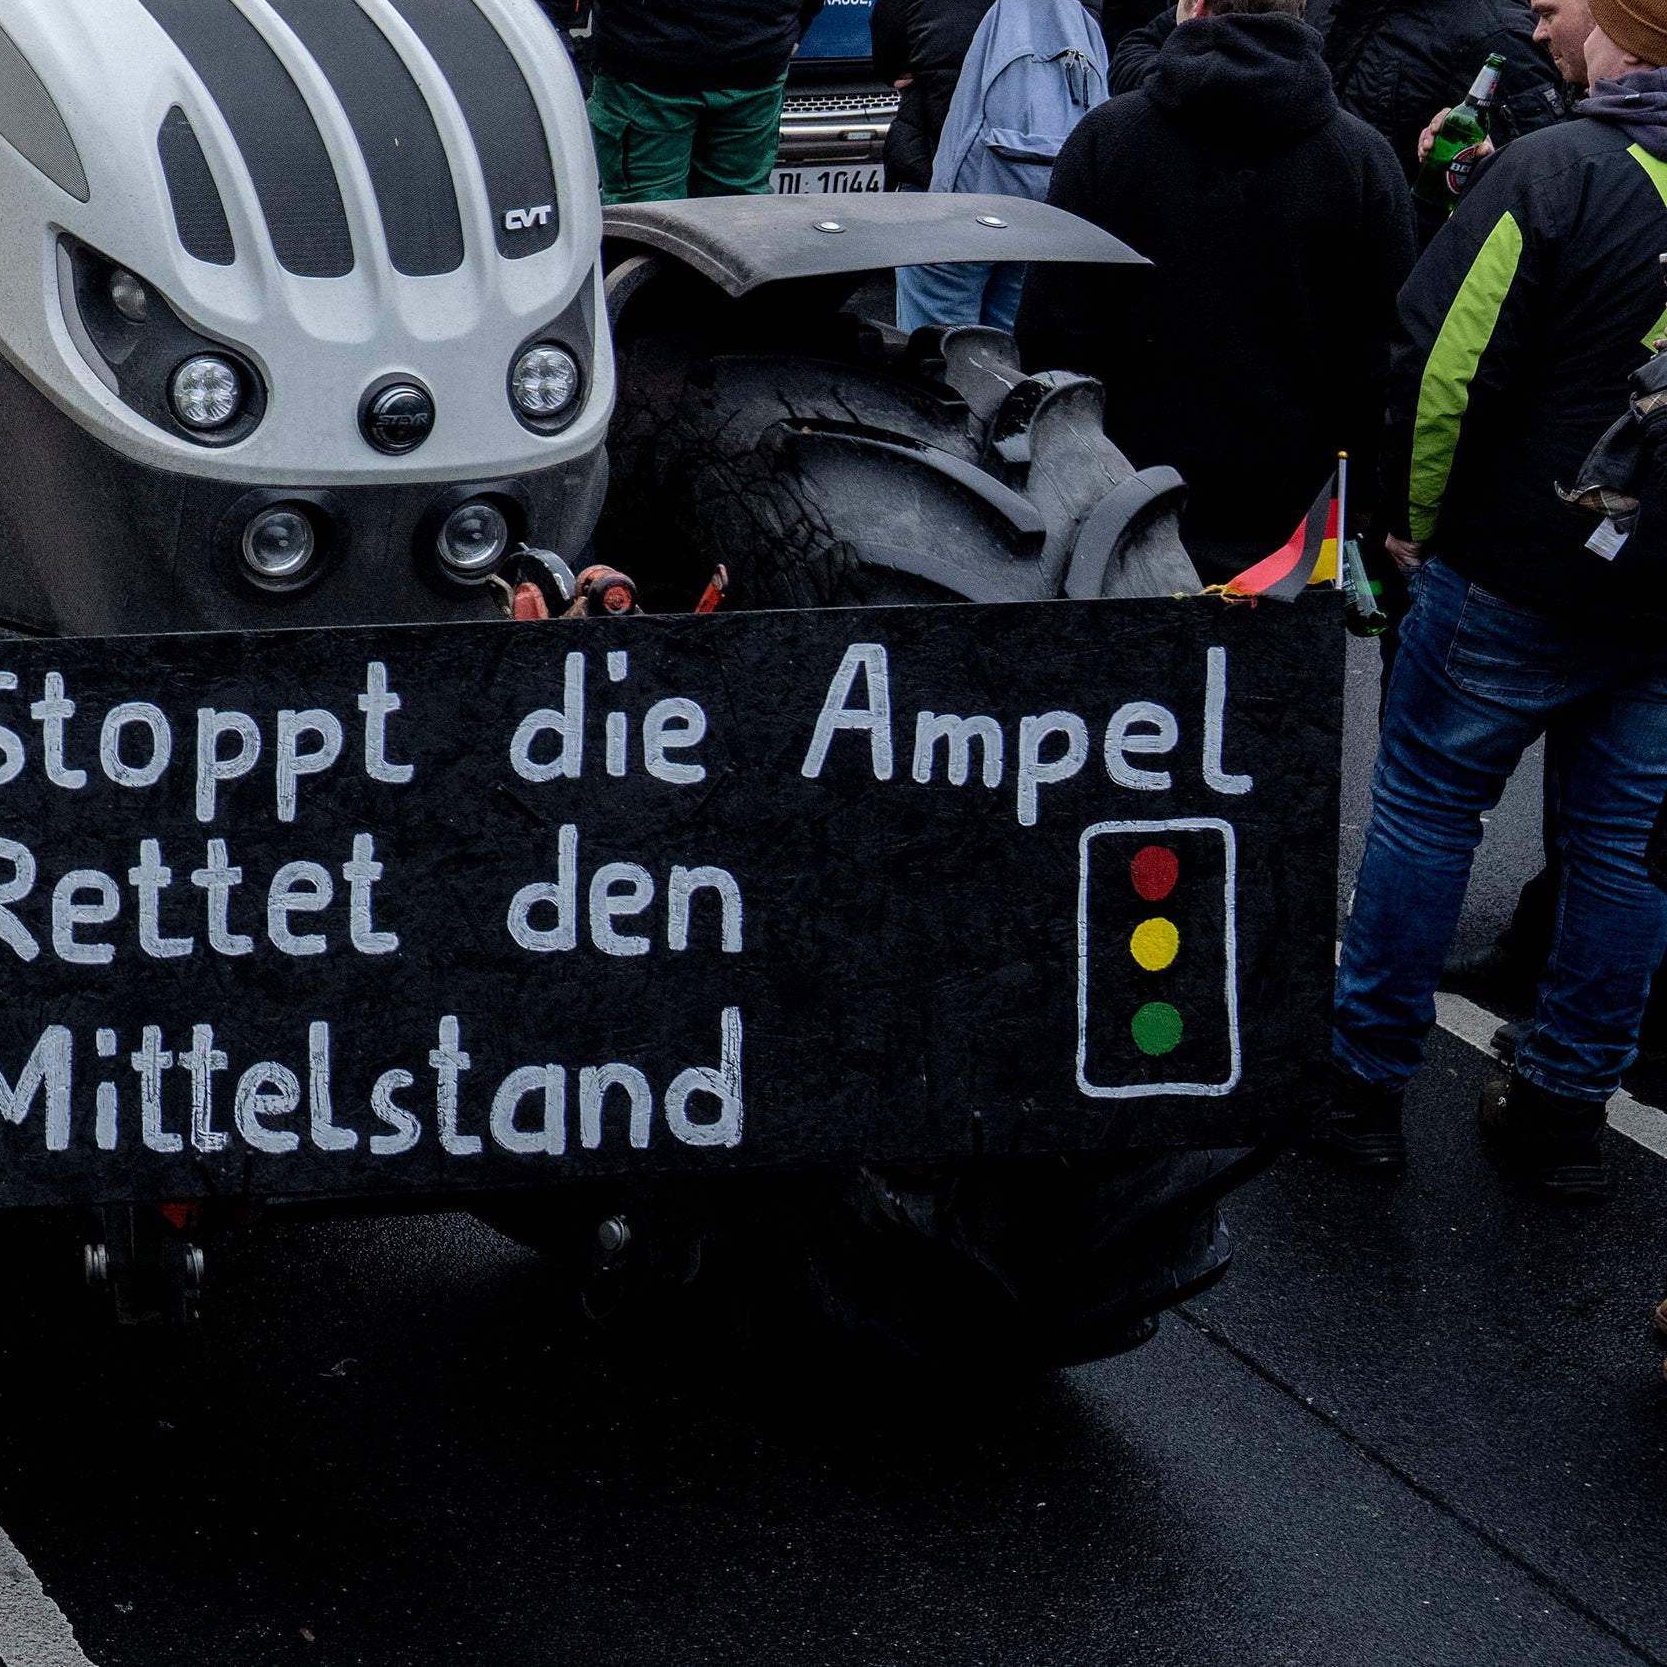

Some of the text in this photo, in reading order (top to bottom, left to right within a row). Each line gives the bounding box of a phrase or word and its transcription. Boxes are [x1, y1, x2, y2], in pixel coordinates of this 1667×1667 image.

[505, 204, 551, 230] CVT
[375, 413, 428, 426] STEYR
[509, 648, 709, 786] die
[800, 642, 1255, 827] Ampel
[507, 824, 744, 956] den
